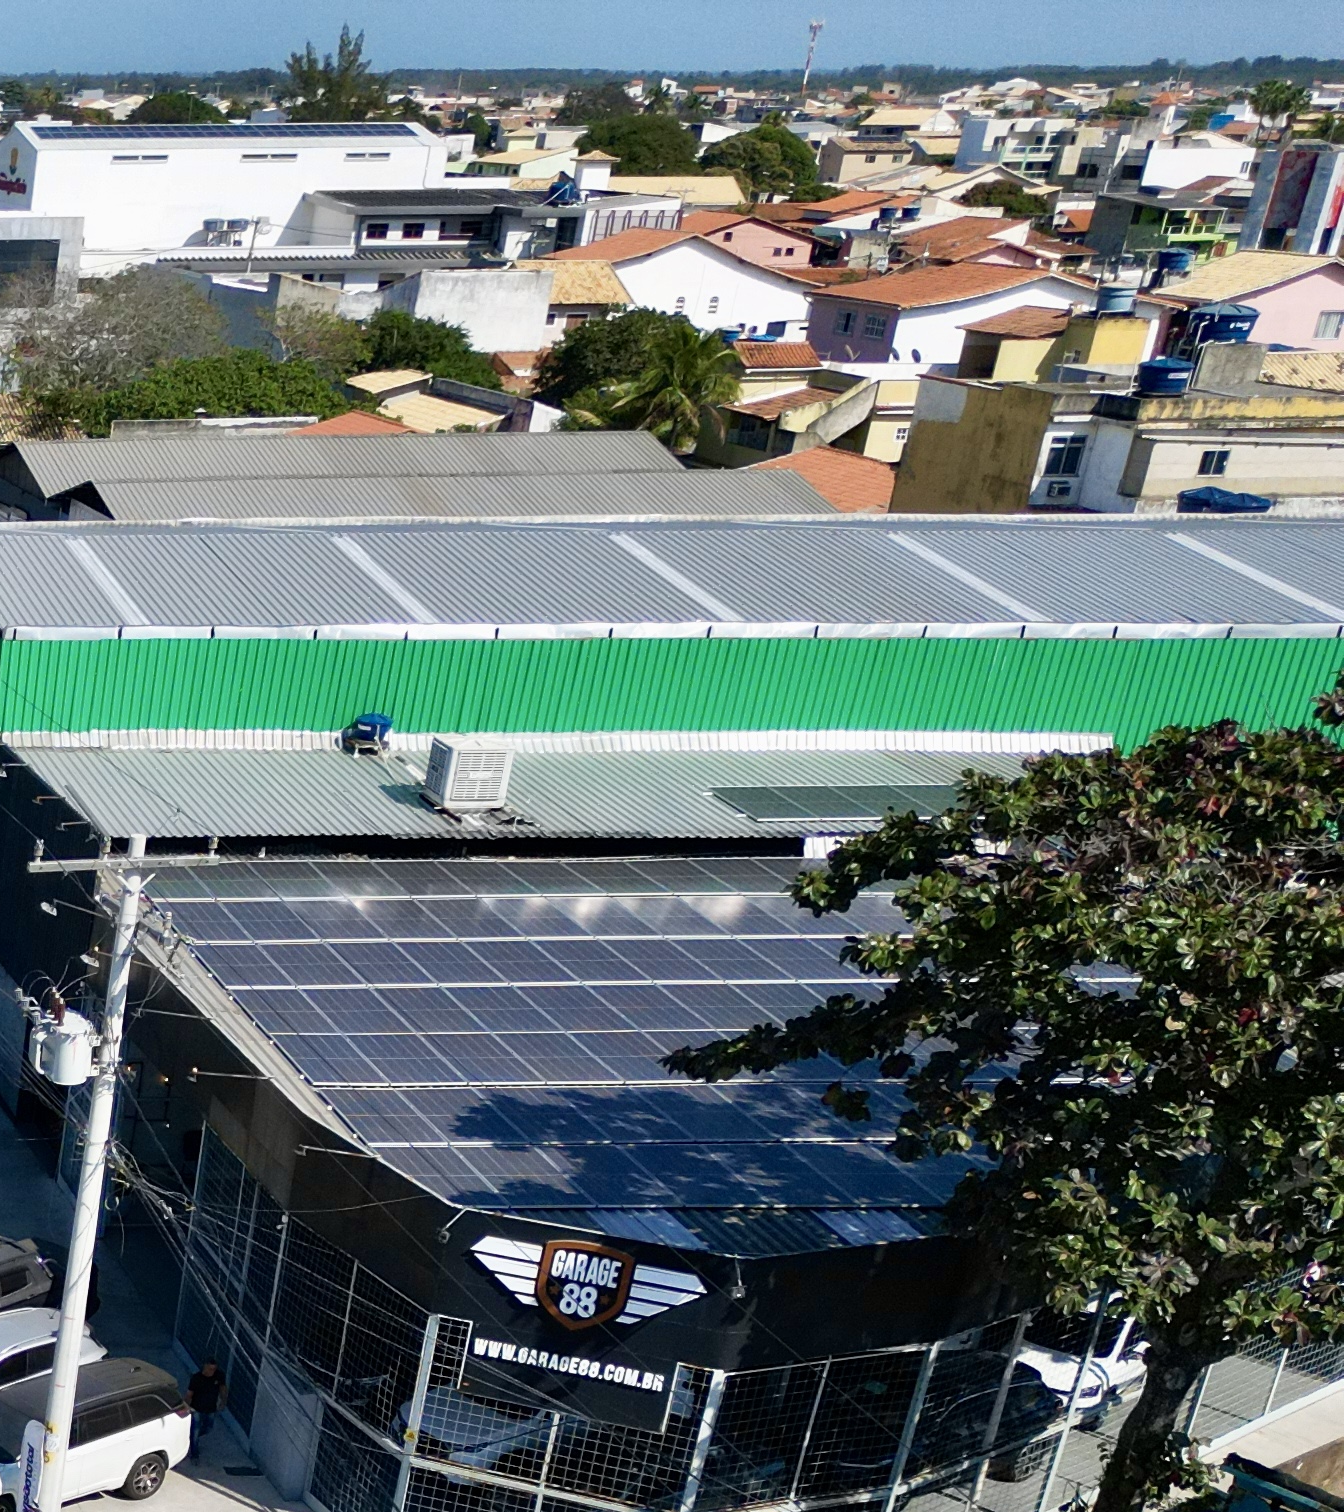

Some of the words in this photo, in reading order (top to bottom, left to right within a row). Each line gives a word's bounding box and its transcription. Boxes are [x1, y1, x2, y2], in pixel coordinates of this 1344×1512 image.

[550, 1249, 624, 1290] GARAGE
[558, 1282, 599, 1319] 88
[473, 1337, 666, 1393] WWW.GARAGE88.COM.BR
